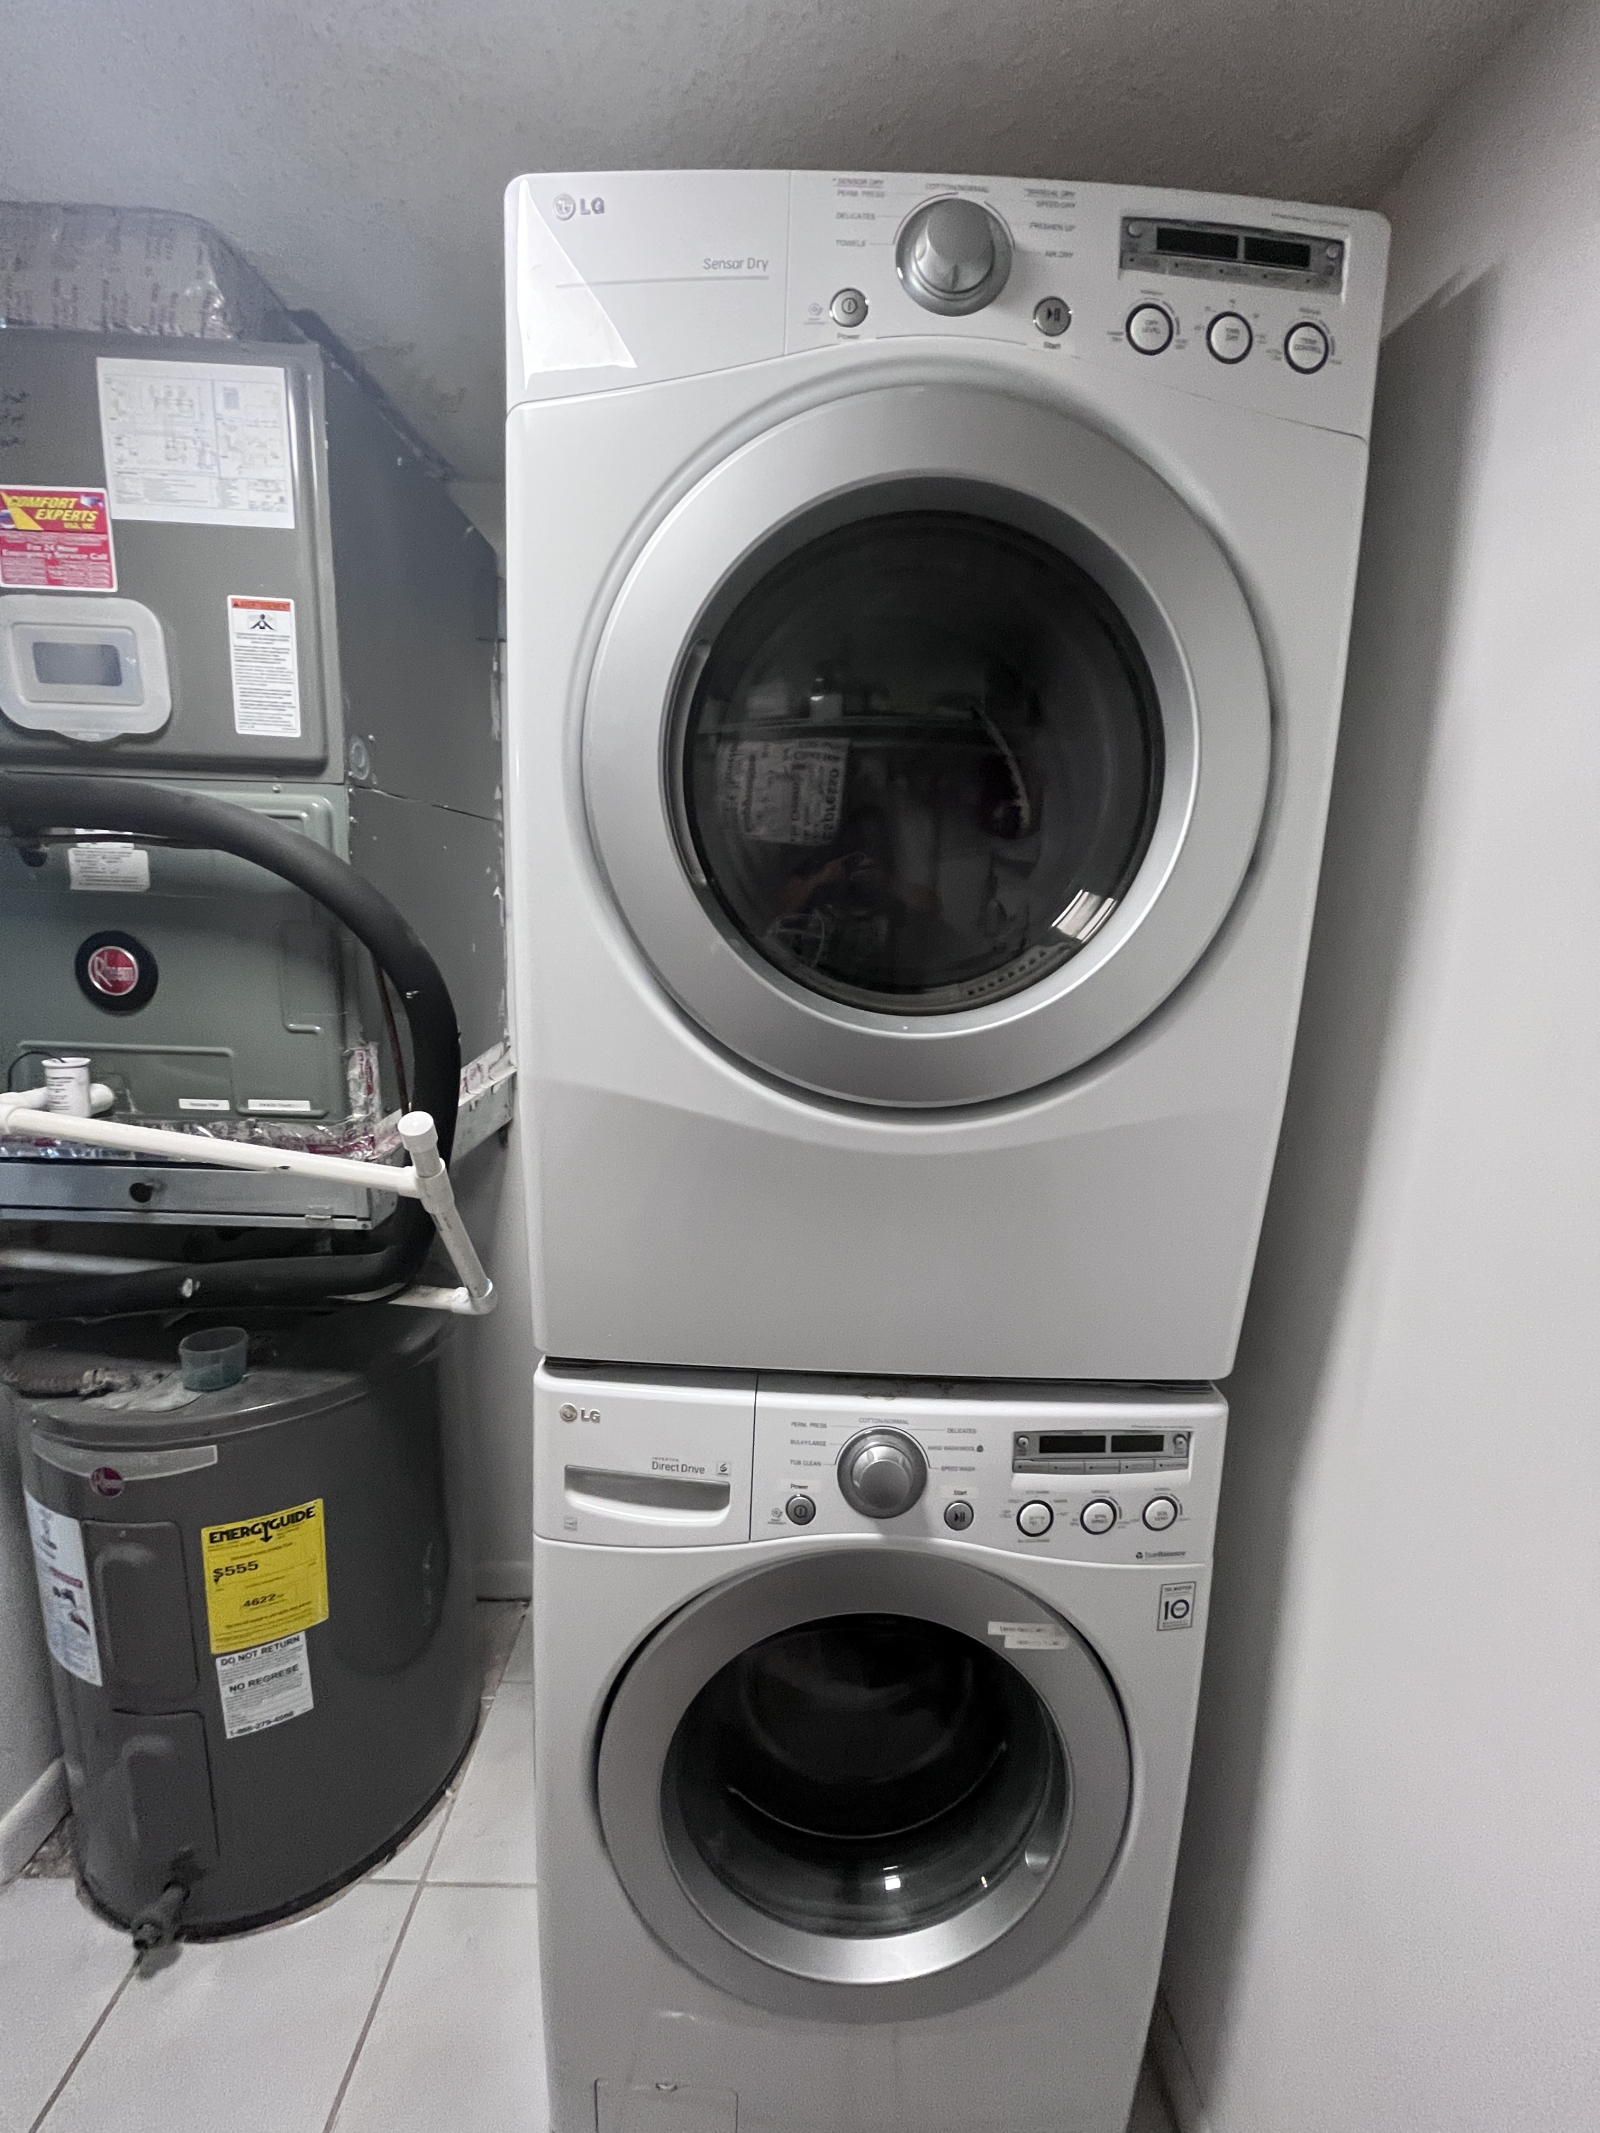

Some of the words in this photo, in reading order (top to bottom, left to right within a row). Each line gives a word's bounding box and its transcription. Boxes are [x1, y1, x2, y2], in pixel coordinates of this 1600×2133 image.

[580, 197, 605, 216] LG
[836, 212, 876, 220] DELICATES
[703, 258, 744, 270] Sensor
[747, 257, 769, 272] Dry
[35, 509, 99, 522] EXPERTS
[54, 551, 88, 560] Service
[580, 1408, 601, 1423] LG
[652, 1461, 680, 1473] Direct
[681, 1464, 706, 1475] Drive
[209, 1506, 316, 1543] ENERGYGUIDE
[213, 1560, 259, 1579] $555
[243, 1593, 276, 1608] 4622
[1164, 1599, 1190, 1620] 10
[220, 1657, 236, 1666] DO
[238, 1650, 258, 1662] NOT
[261, 1635, 300, 1655] RETURN
[229, 1682, 246, 1693] NO
[248, 1663, 299, 1688] REGRESE
